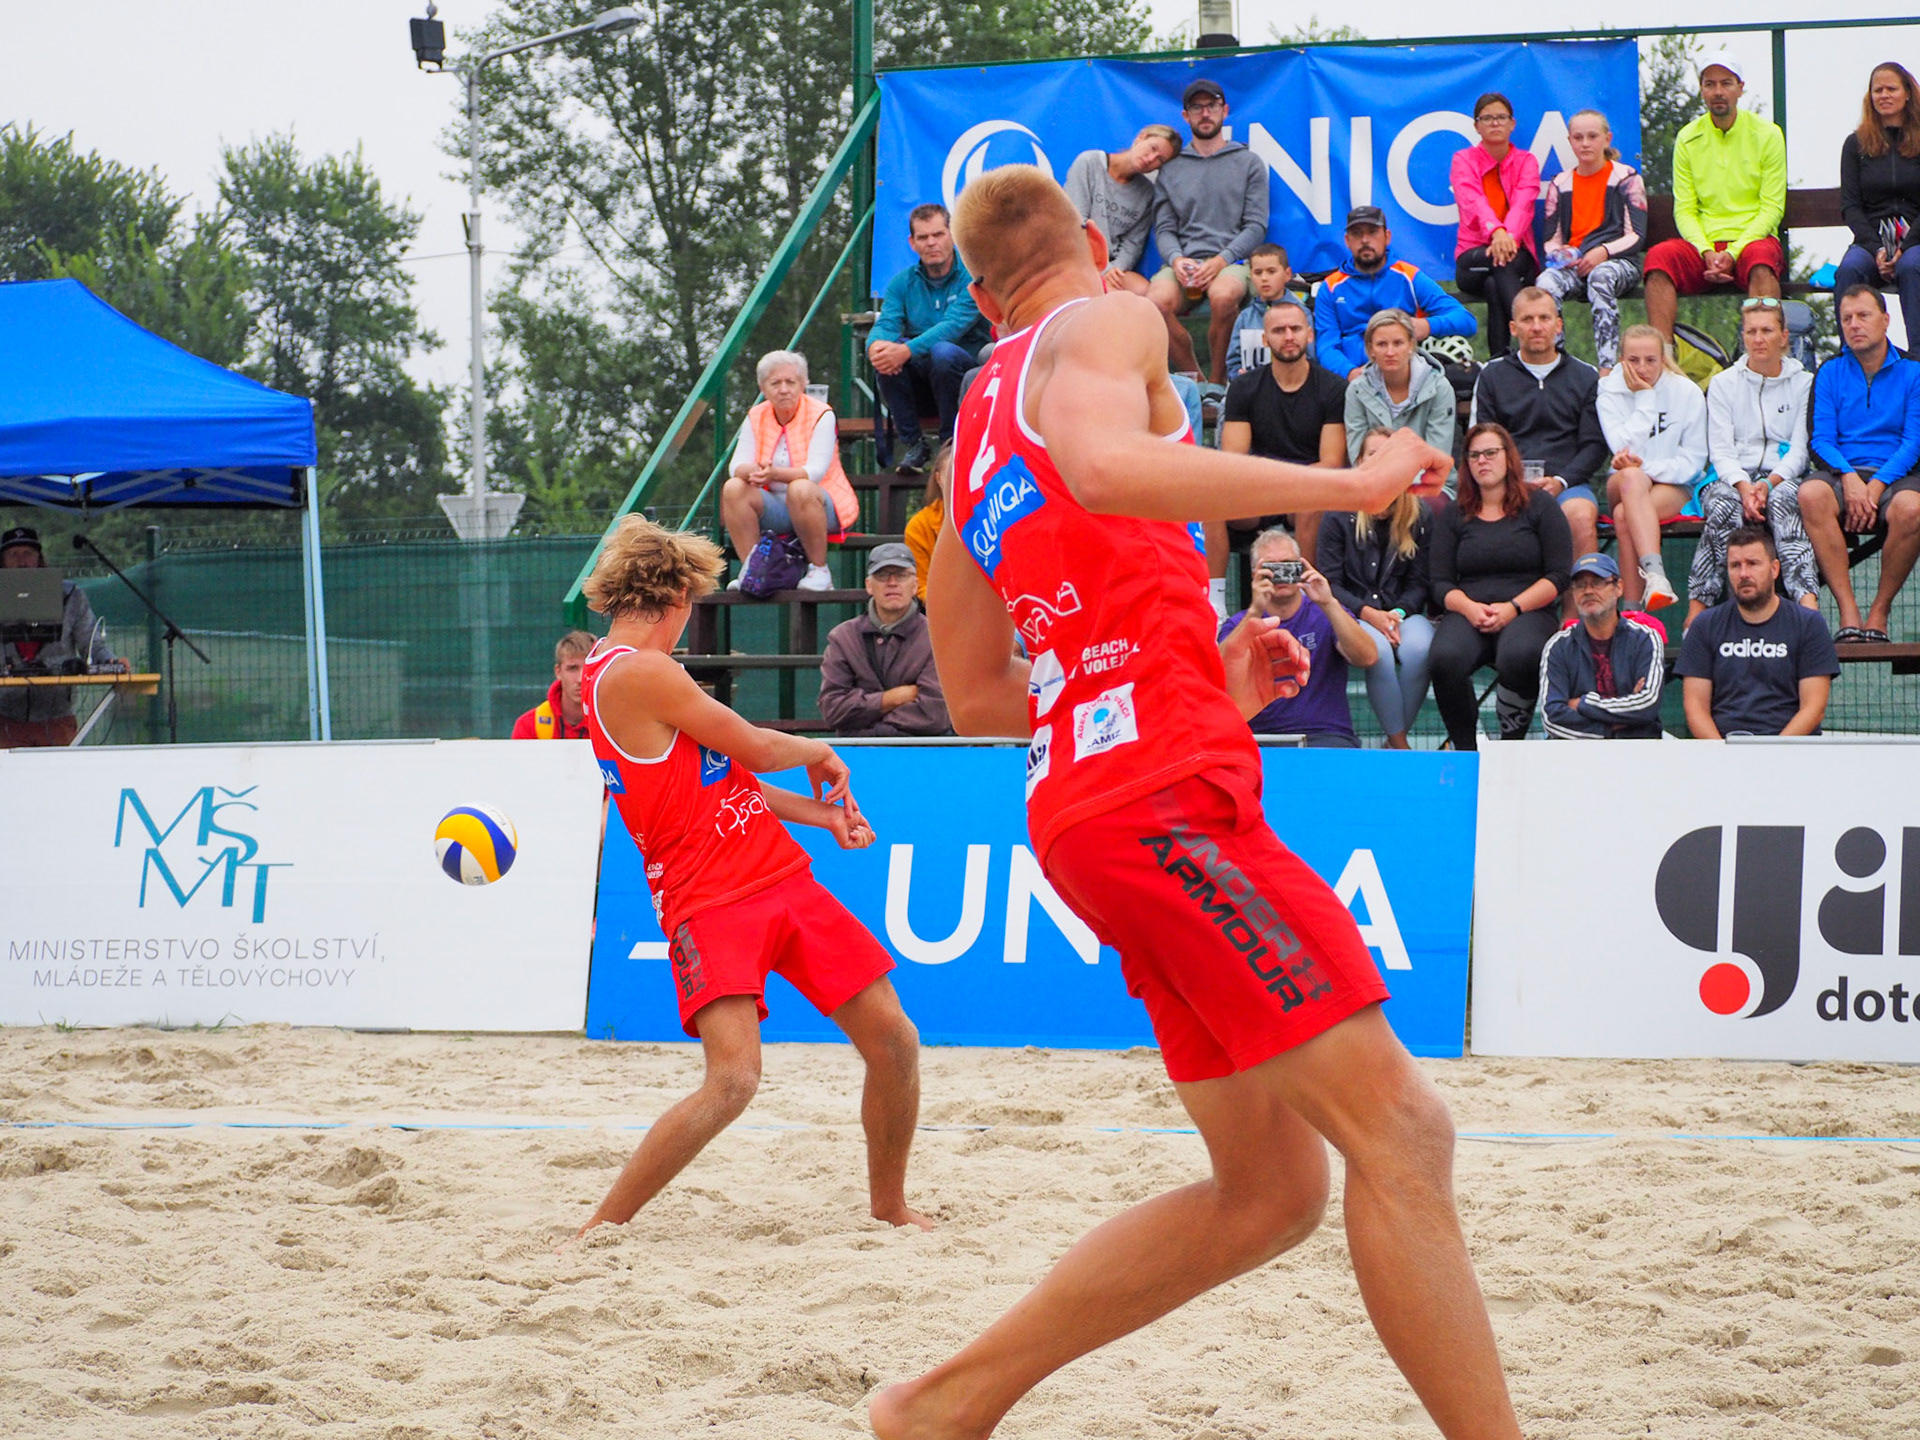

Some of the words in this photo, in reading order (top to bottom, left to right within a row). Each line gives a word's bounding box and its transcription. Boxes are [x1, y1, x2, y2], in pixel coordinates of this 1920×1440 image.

[1143, 110, 1580, 227] NIQA
[1081, 637, 1129, 662] BEACH
[1719, 638, 1788, 658] adidas
[884, 843, 1413, 971] UNA
[1169, 822, 1303, 962] UNDER
[9, 938, 220, 961] MINISTERSTVO
[233, 932, 386, 963] ŠKOLSTVÍ,
[1138, 835, 1306, 1014] ARMOUR
[33, 964, 143, 988] MLÁDEŽE
[151, 968, 168, 988] A
[177, 963, 356, 988] TĚLOVÝCHOVY
[1816, 975, 1920, 1023] dot
